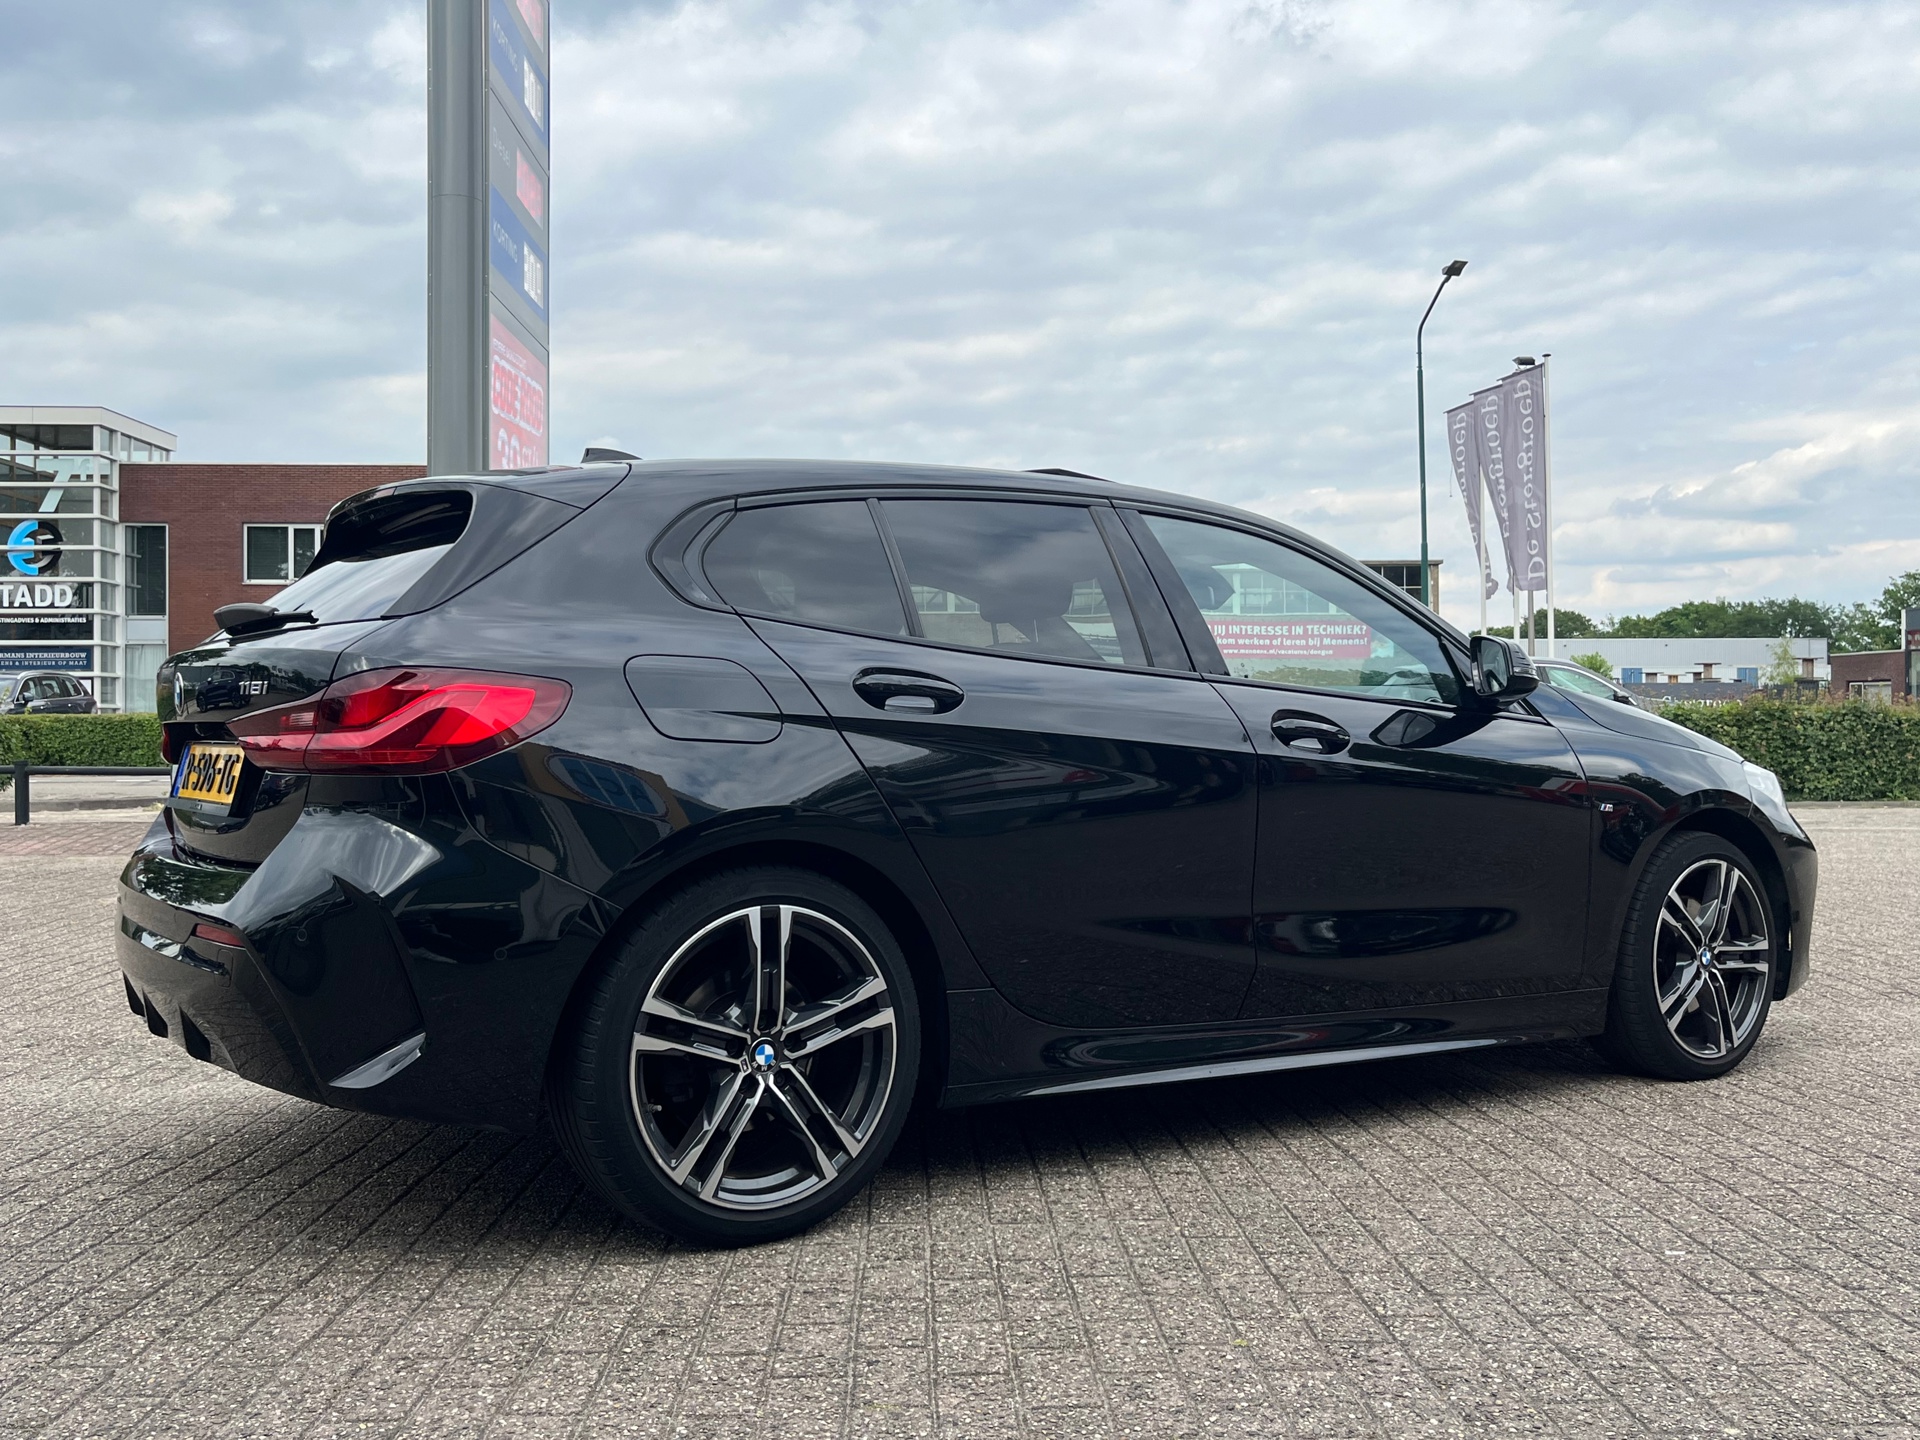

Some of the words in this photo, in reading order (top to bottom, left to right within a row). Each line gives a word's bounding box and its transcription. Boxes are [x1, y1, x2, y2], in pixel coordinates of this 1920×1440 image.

[493, 217, 518, 264] KORTING
[1214, 624, 1226, 636] JIJ
[1229, 624, 1289, 636] INTERESSE
[1292, 625, 1304, 635] IN
[1306, 624, 1367, 635] TECHNIEK?
[1217, 636, 1236, 645] kom
[1238, 636, 1270, 646] werken
[1272, 637, 1282, 646] of
[1283, 637, 1307, 646] leren
[1308, 637, 1320, 648] bij
[238, 681, 268, 695] 118i
[181, 752, 240, 796] R-596-TG
[751, 1060, 777, 1072] BMW
